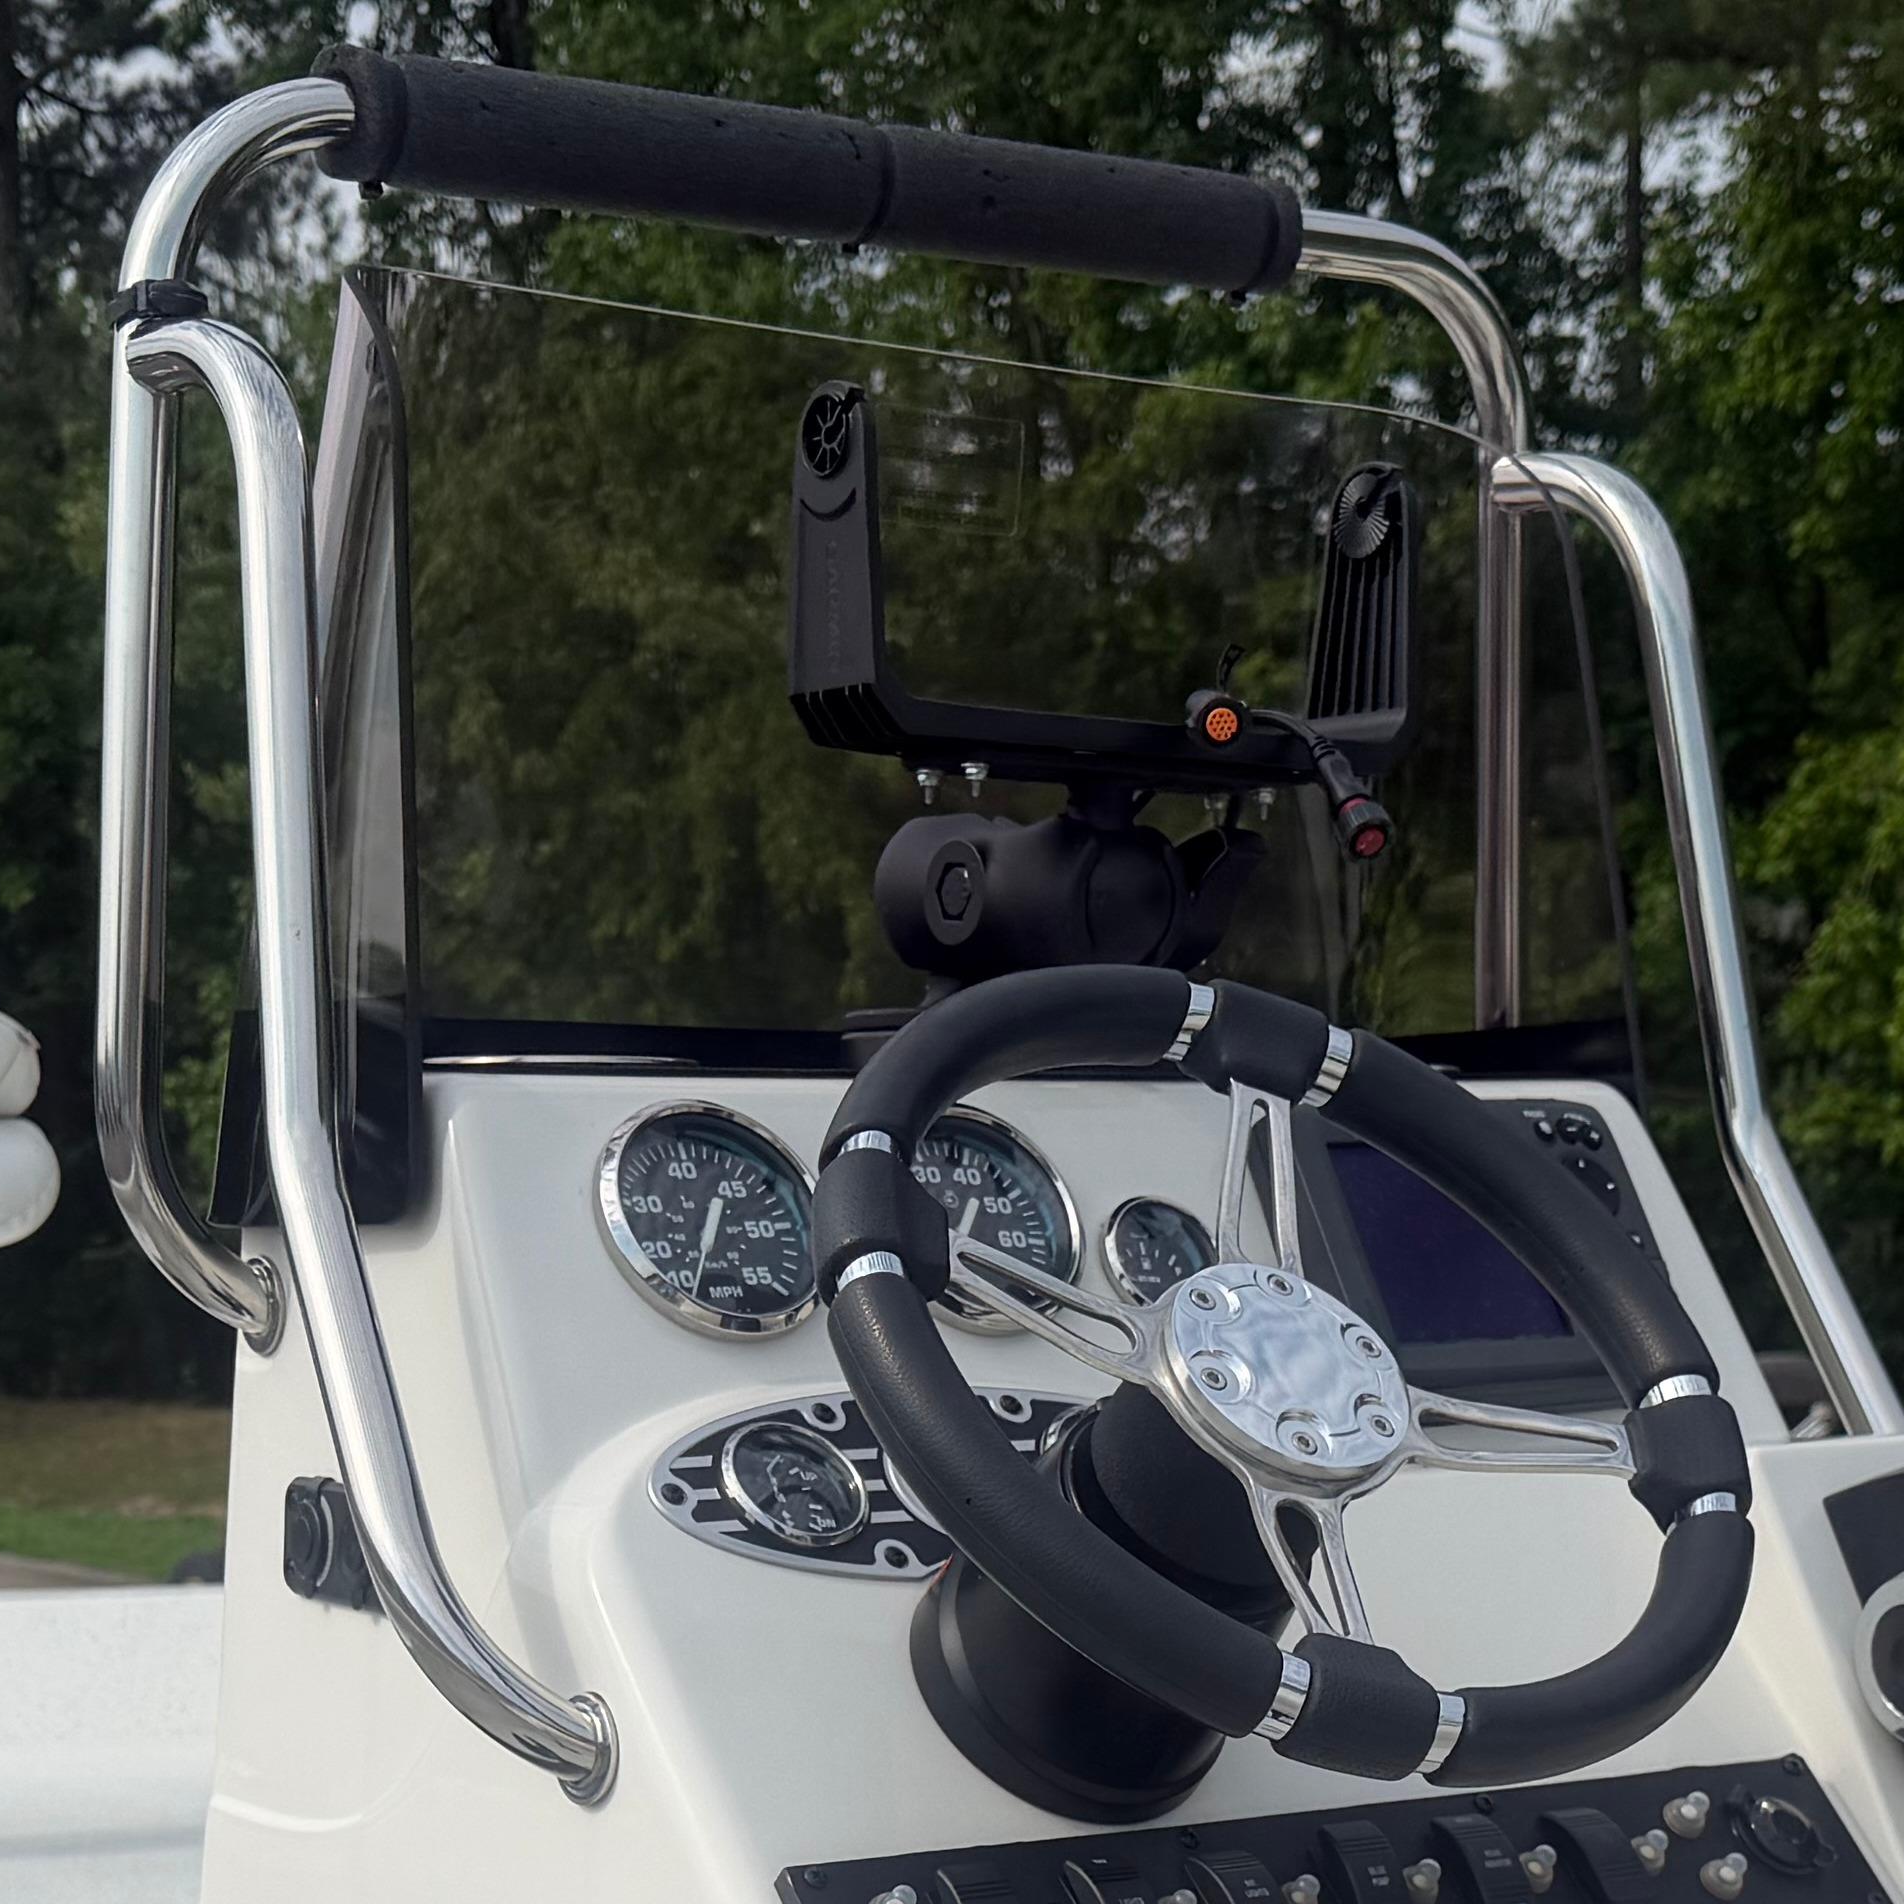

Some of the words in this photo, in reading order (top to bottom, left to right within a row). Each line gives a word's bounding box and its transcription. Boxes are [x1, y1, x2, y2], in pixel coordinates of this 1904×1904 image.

[668, 1161, 697, 1180] 40
[911, 1166, 941, 1183] 30
[953, 1168, 981, 1185] 40
[718, 1181, 747, 1198] 45
[633, 1195, 663, 1213] 30
[983, 1197, 1012, 1214] 50
[744, 1220, 775, 1238] 50
[998, 1231, 1027, 1248] 60
[642, 1241, 672, 1259] 20
[667, 1270, 695, 1288] 10
[742, 1267, 772, 1285] 55
[709, 1286, 743, 1298] MPH
[799, 1470, 817, 1481] UP
